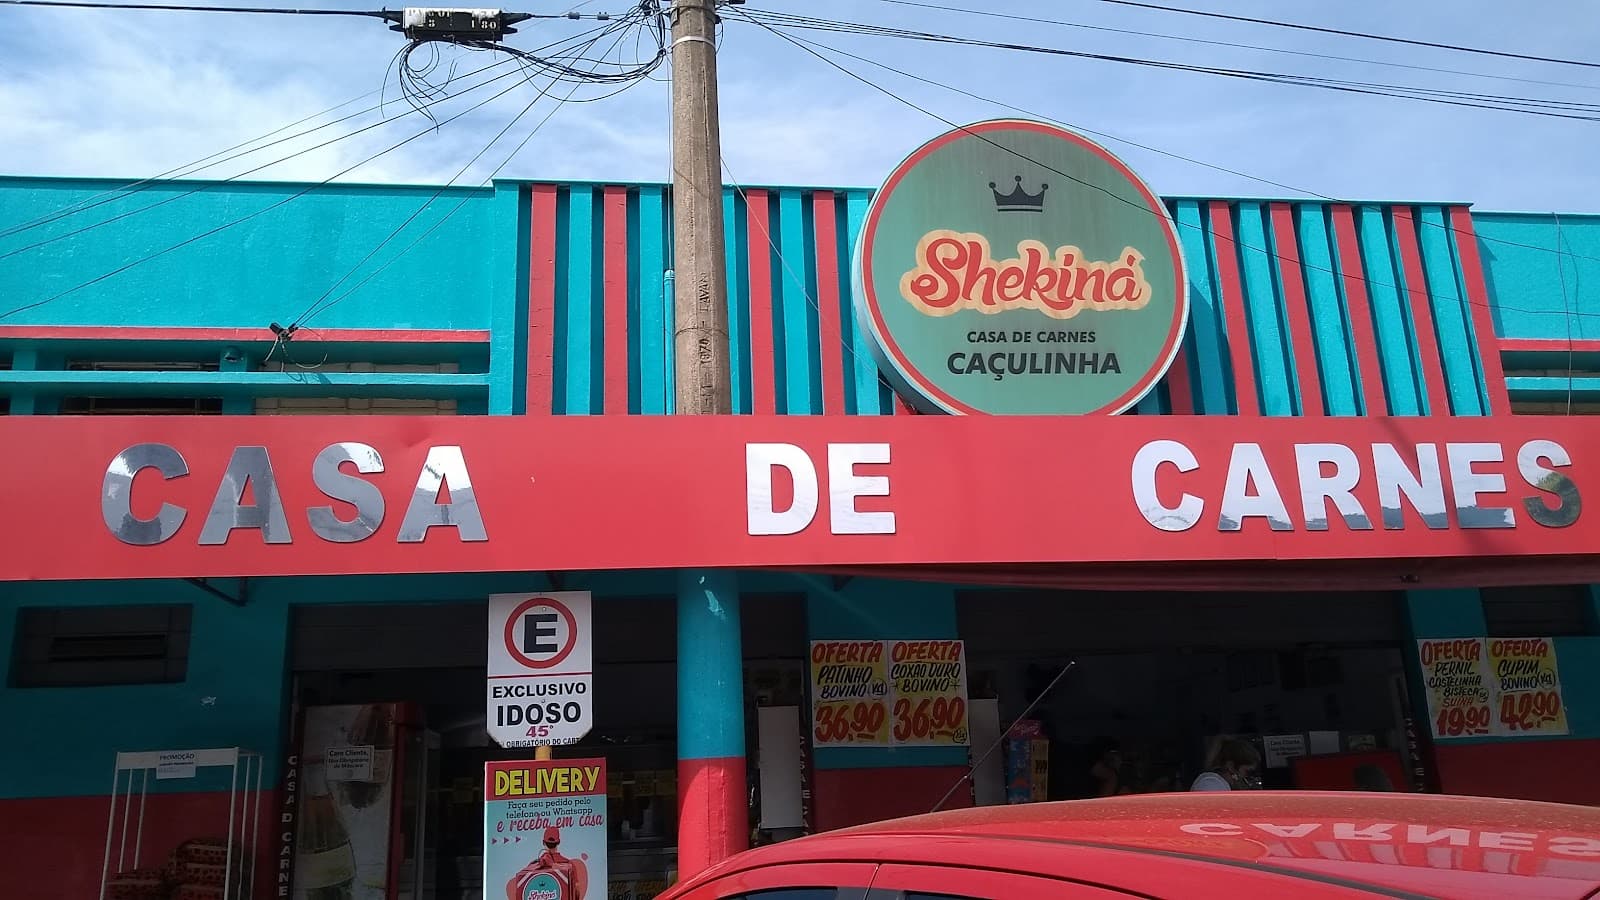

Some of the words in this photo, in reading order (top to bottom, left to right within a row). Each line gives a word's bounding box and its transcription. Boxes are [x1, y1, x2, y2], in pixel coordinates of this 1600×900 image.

[910, 237, 1142, 311] Shekiná
[966, 331, 1007, 343] CASA
[1012, 331, 1032, 343] DE
[1036, 331, 1096, 343] CARNES
[947, 352, 1121, 381] CAÇULINHA
[101, 442, 489, 546] CASA
[746, 442, 896, 536] DE
[1131, 439, 1582, 532] CARNES
[523, 613, 559, 654] E
[812, 642, 883, 664] OFERTA
[892, 641, 962, 662] OFERTA
[1421, 638, 1481, 666] OFERTA
[1491, 638, 1549, 658] OFERTA
[817, 664, 873, 686] PATINHO
[928, 662, 961, 679] DURO
[1434, 661, 1475, 677] PERNIL
[1497, 659, 1539, 677] CUPIM
[492, 682, 587, 699] EXCLUSIVO
[821, 683, 867, 699] BOVINO
[902, 677, 951, 692] BOVINO
[1429, 675, 1482, 688] COSTELINHA
[1501, 677, 1538, 691] BOVINO
[1444, 687, 1479, 697] BISTECA
[497, 701, 582, 727] IDOSO
[494, 765, 601, 797] DELIVERY
[508, 801, 527, 810] Faça
[545, 798, 573, 809] pedido
[574, 797, 592, 806] pelo
[552, 807, 593, 817] Whatsapp
[496, 822, 505, 833] e
[509, 813, 551, 832] receba
[555, 817, 575, 829] em
[578, 814, 605, 827] casa
